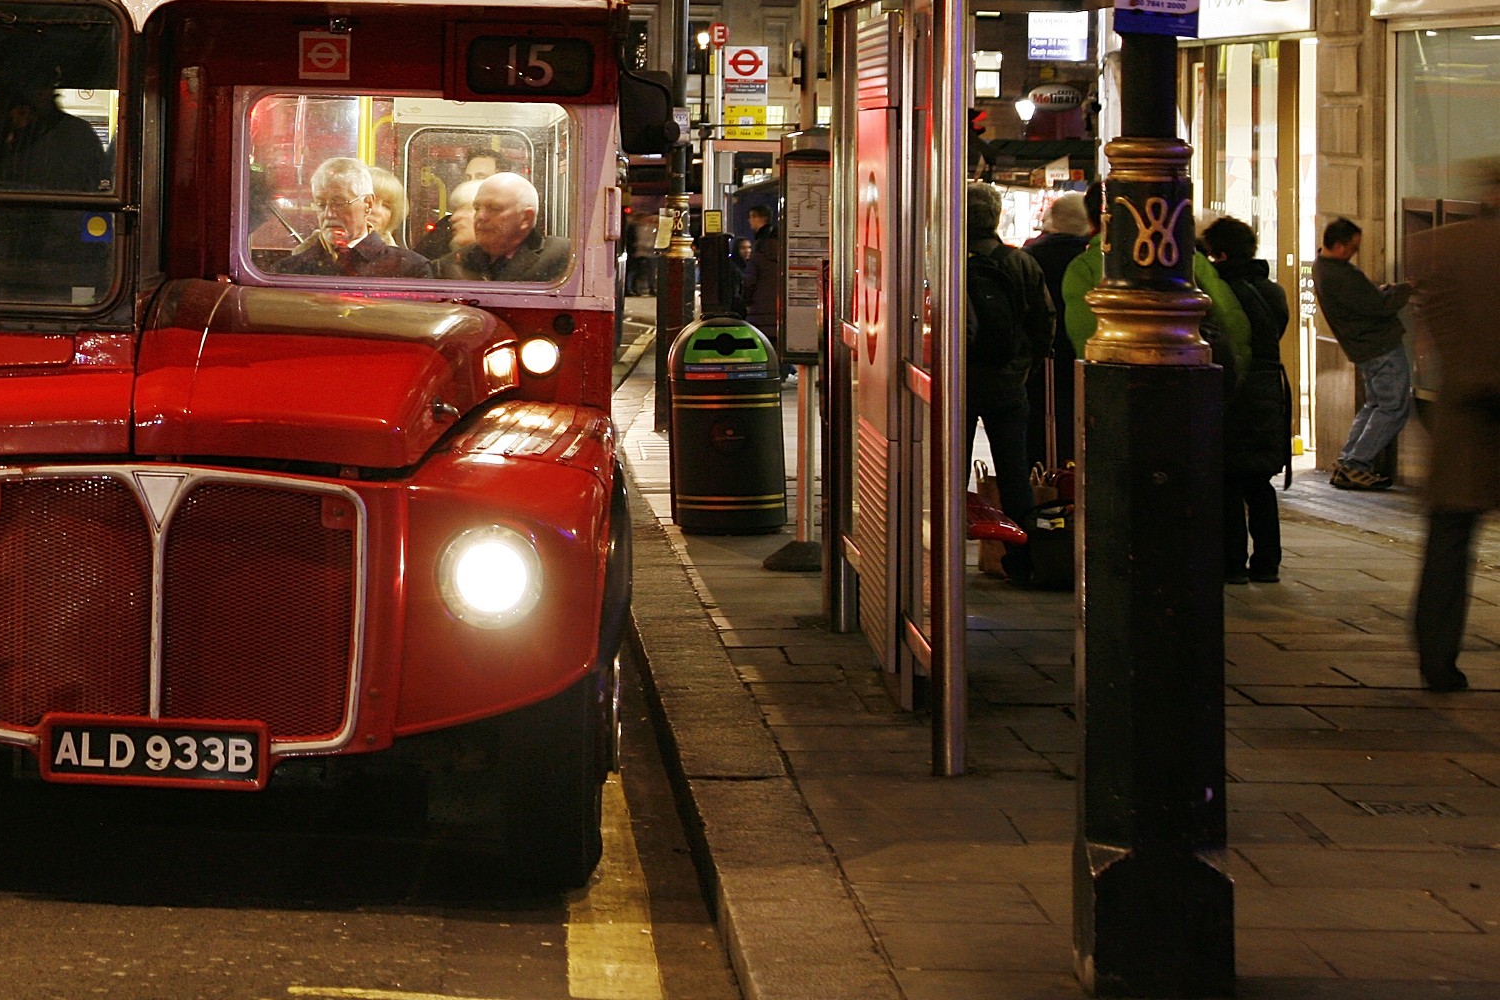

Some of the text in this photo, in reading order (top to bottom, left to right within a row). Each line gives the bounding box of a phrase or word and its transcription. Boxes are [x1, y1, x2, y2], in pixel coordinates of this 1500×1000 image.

[713, 26, 726, 42] E
[507, 44, 556, 88] 15
[54, 731, 254, 773] ALD 933B
